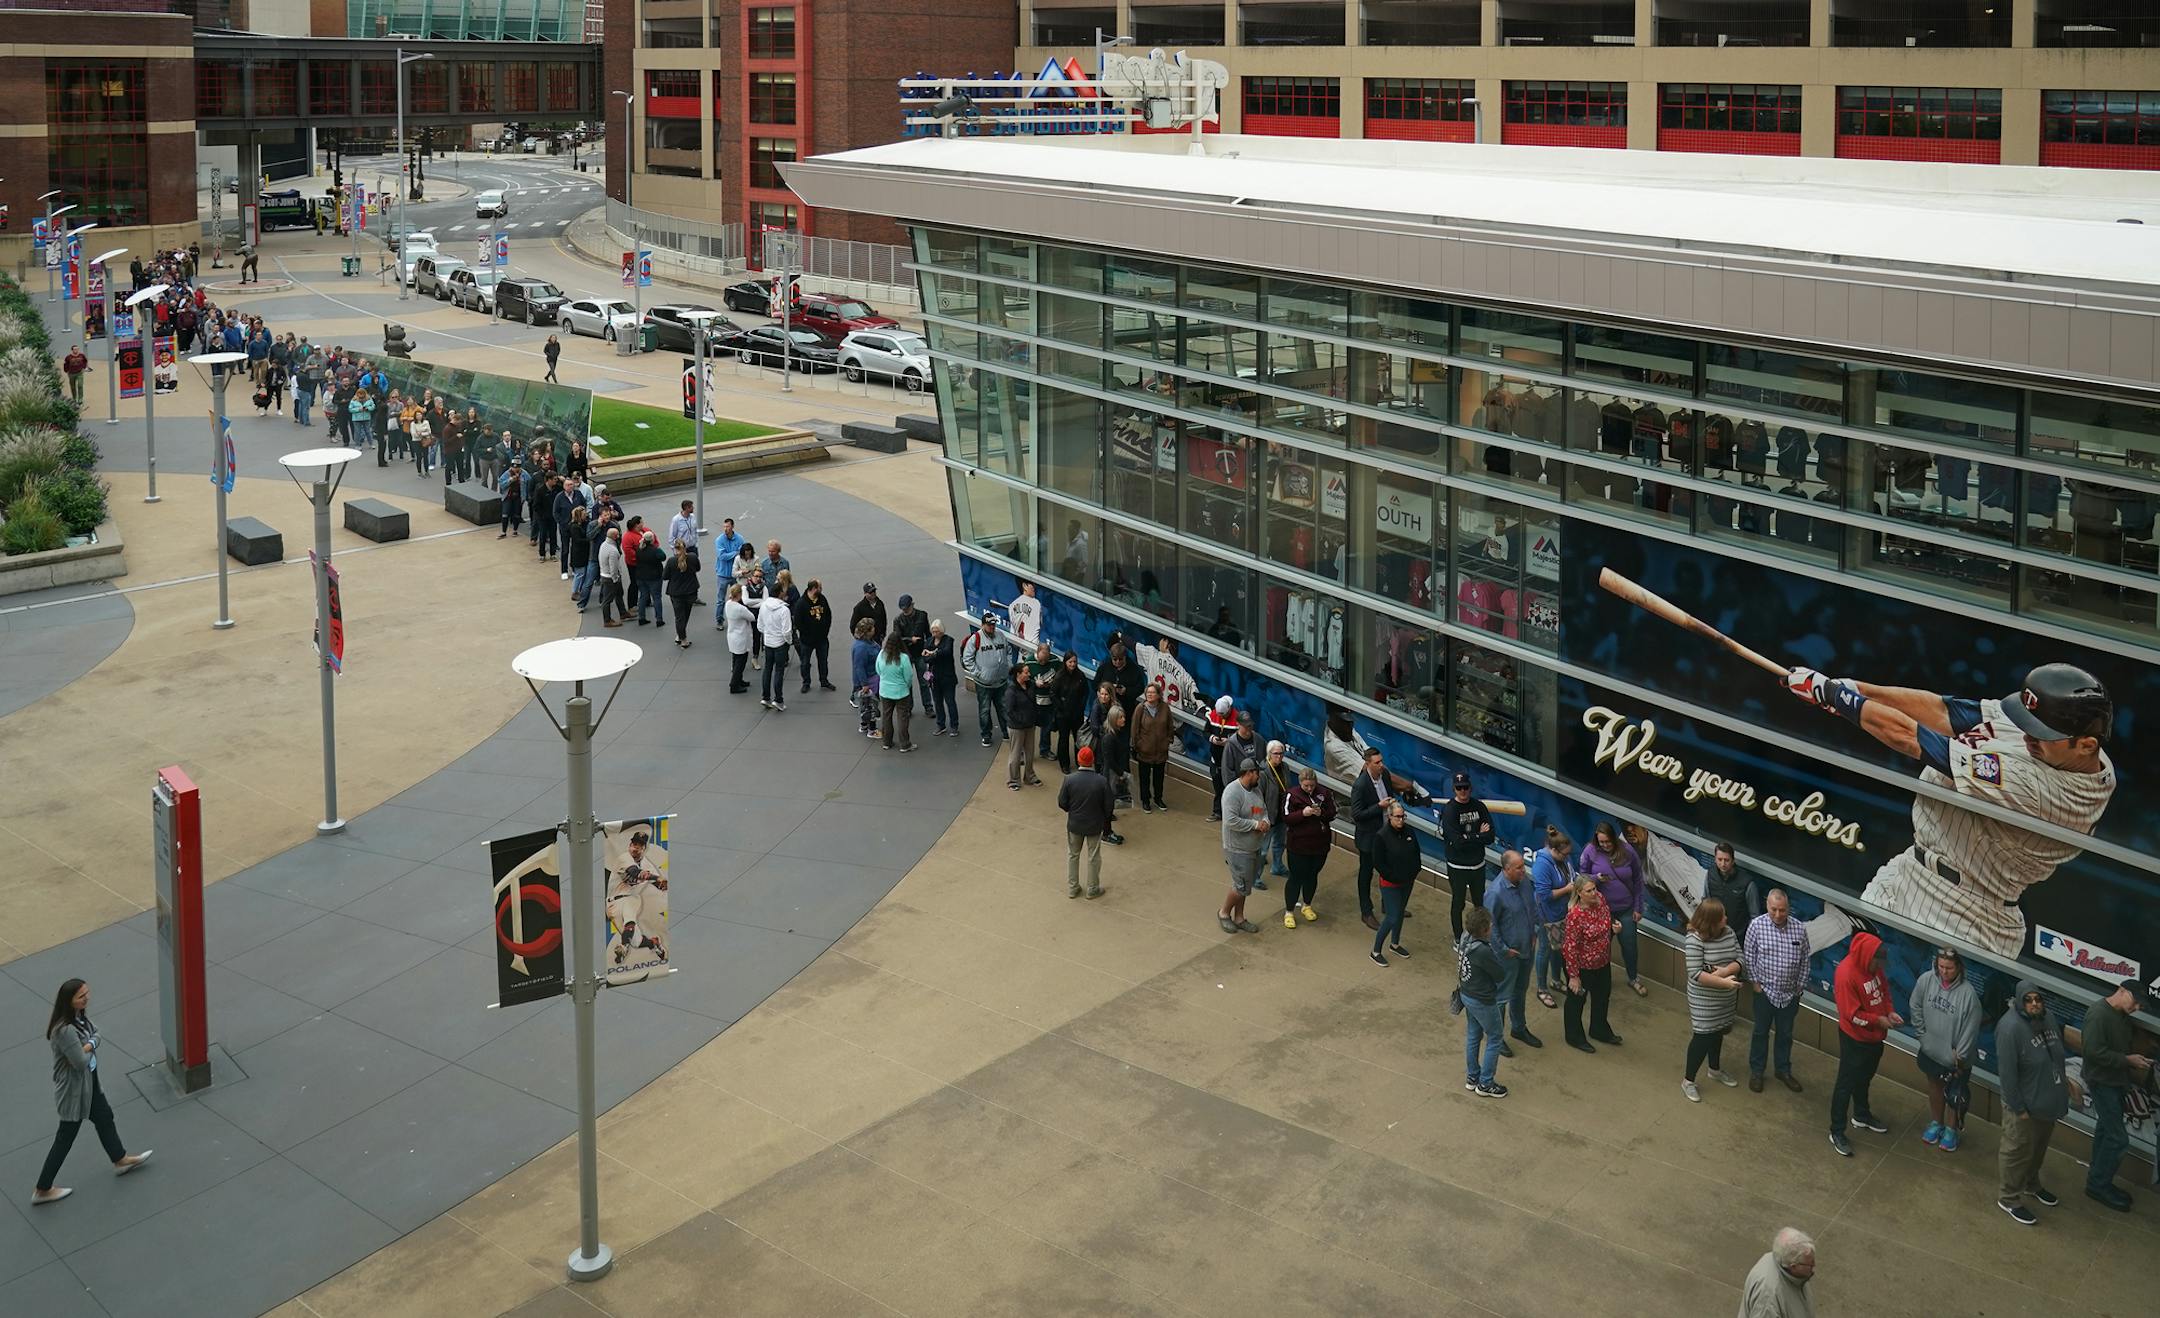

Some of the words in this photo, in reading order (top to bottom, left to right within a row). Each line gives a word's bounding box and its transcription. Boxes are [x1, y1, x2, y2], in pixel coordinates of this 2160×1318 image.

[1377, 506, 1421, 532] OUTH
[1158, 658, 1180, 679] RADKE
[1583, 706, 1684, 783] Wear
[1683, 767, 1757, 809] your
[1763, 791, 1866, 852] colors.
[607, 959, 669, 974] POLANCO
[2070, 948, 2136, 977] Authentic
